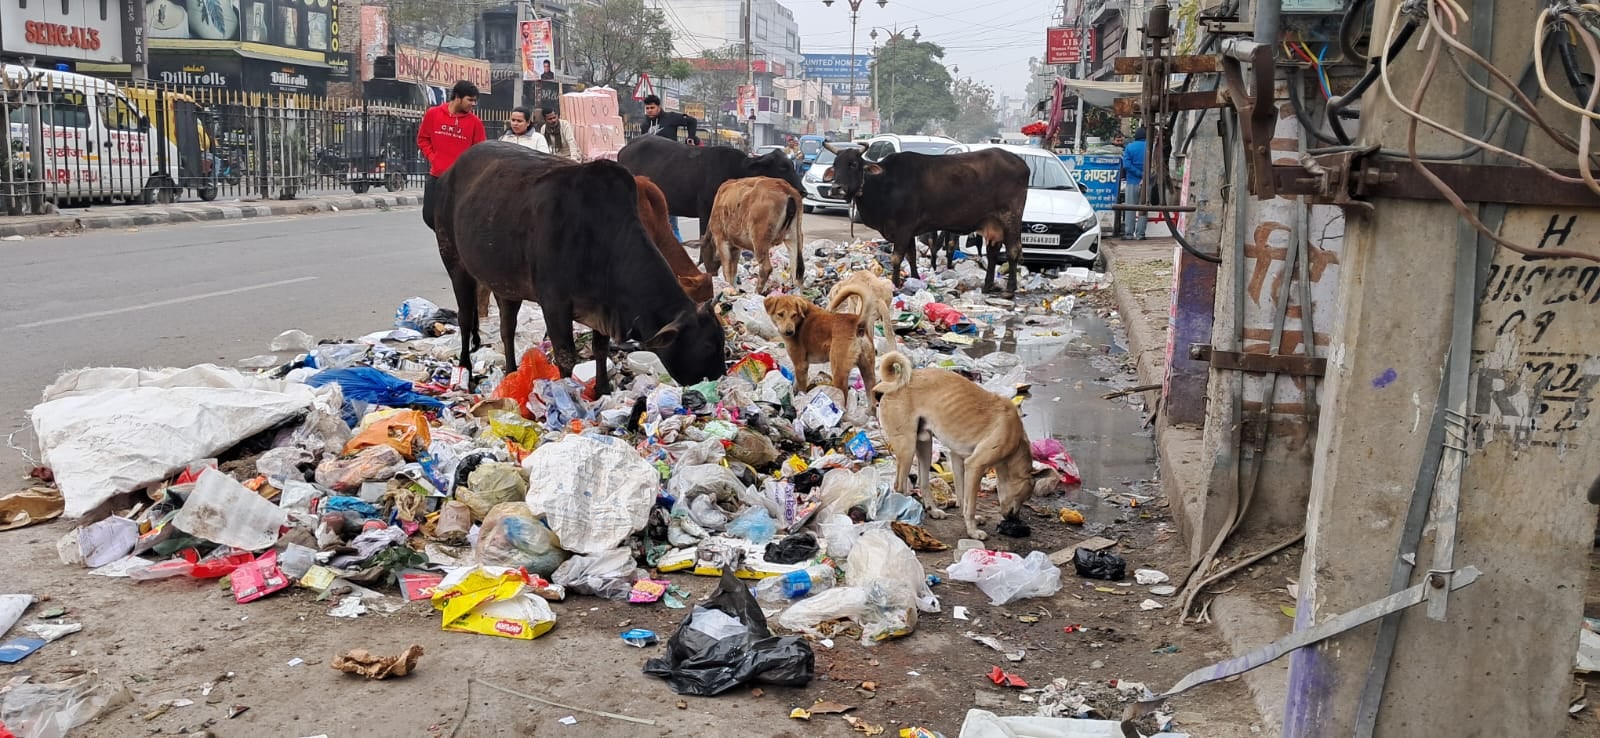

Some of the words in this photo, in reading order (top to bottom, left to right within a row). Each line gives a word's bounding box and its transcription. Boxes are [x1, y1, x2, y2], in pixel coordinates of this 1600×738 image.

[25, 20, 101, 51] SEHGAL'S
[331, 0, 339, 52] TOO
[135, 27, 143, 62] WEAR
[160, 71, 191, 83] Dilli
[398, 53, 441, 80] BUMPER
[443, 62, 465, 84] SALE
[467, 66, 490, 89] MELA
[805, 59, 833, 67] UNITED
[1084, 169, 1118, 184] भण्डार
[1538, 214, 1577, 248] H
